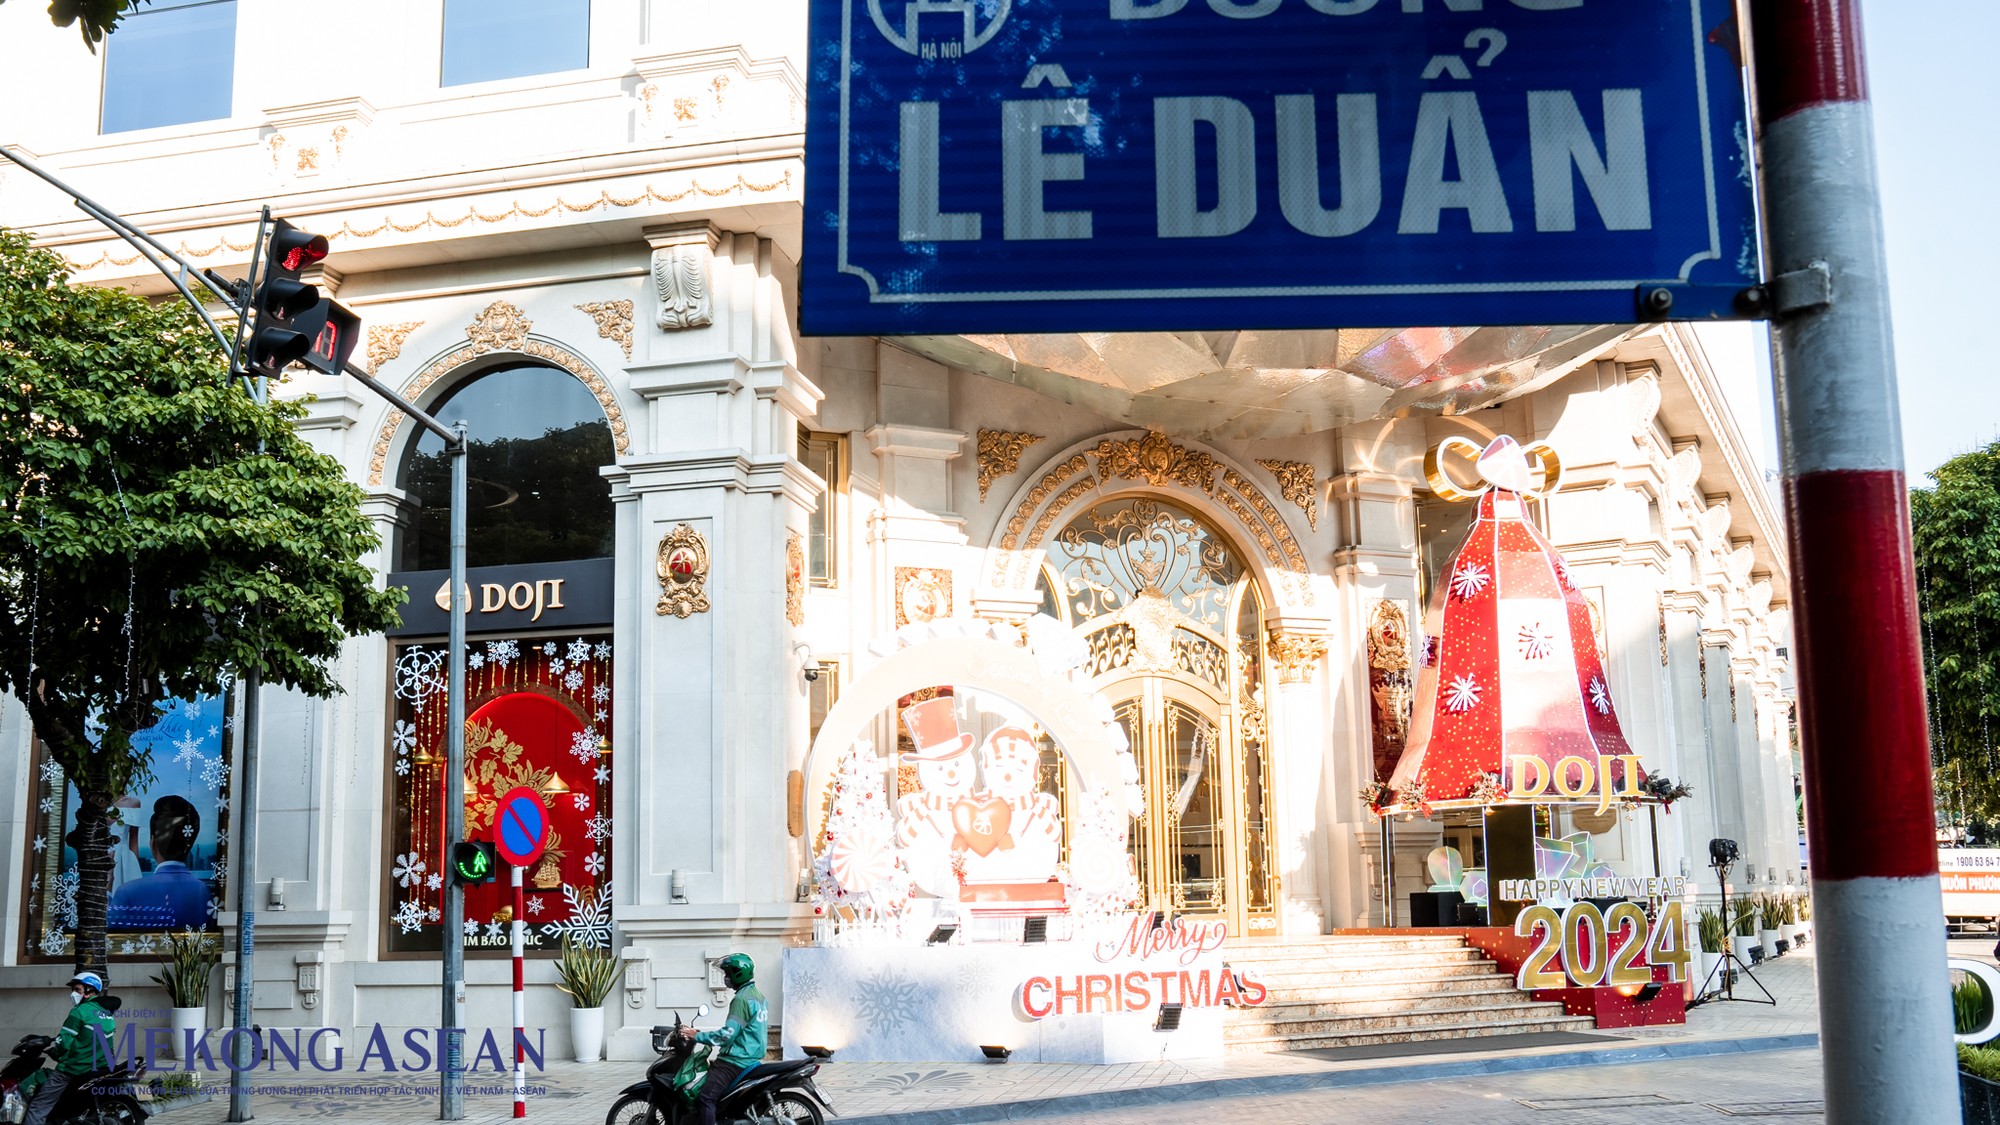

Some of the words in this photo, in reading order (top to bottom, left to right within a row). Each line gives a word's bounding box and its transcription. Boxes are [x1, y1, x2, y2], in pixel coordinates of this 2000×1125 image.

[921, 38, 938, 59] HÀ
[941, 37, 962, 64] NỘI
[898, 63, 1093, 241] LÊ
[1153, 27, 1652, 239] DUẨN
[480, 578, 565, 622] DOJI
[1508, 754, 1646, 817] DOJI
[1956, 856, 1973, 867] 1900
[1975, 856, 1984, 867] 63
[1500, 879, 1575, 900] HAPPY
[1578, 877, 1626, 899] NEW
[1632, 876, 1687, 898] YEAR
[1095, 911, 1228, 966] Merry
[1514, 901, 1692, 990] 2024
[1021, 967, 1268, 1019] CHRISTMAS
